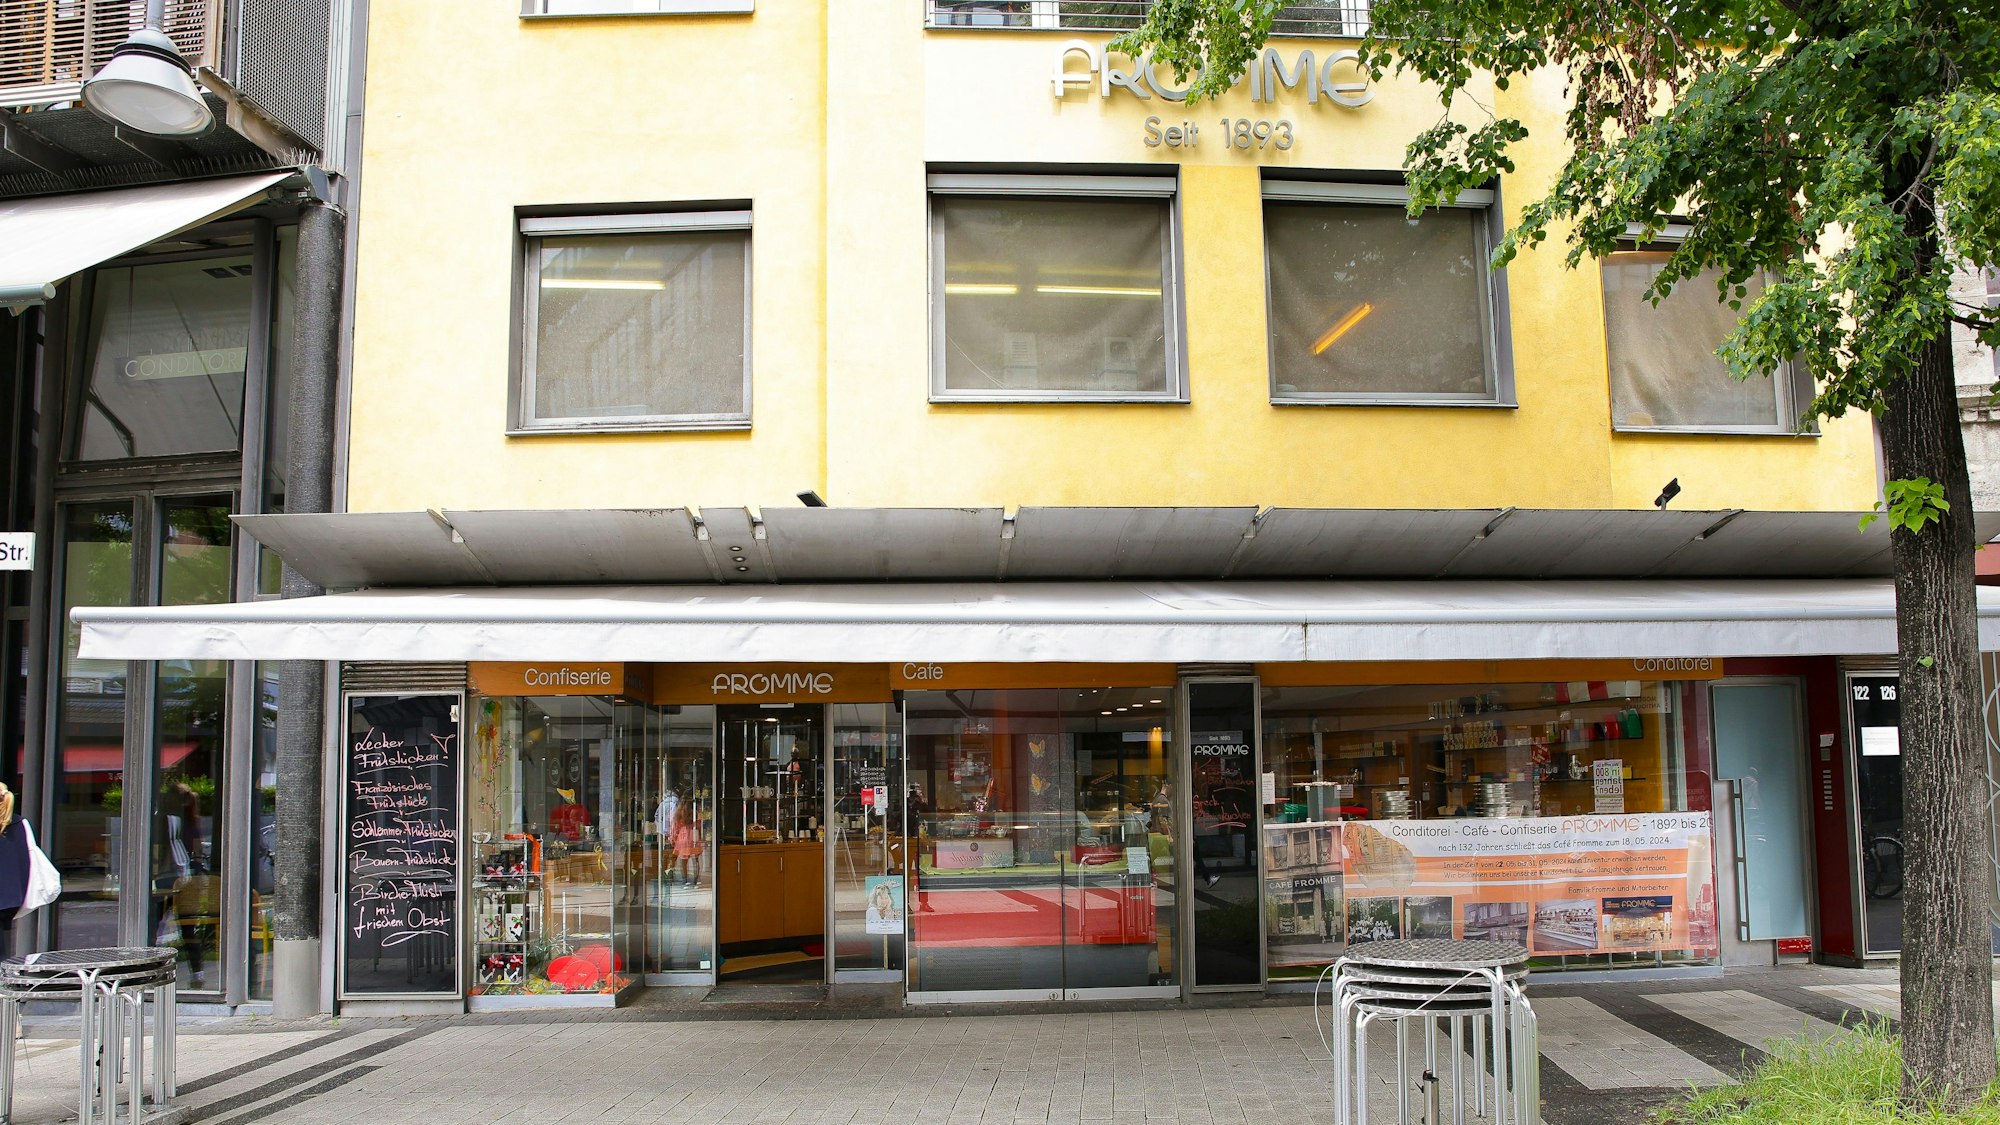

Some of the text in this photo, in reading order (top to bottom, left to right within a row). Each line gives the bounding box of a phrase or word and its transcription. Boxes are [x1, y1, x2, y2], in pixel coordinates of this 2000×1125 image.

[1144, 115, 1295, 151] Seit 1893
[0, 541, 28, 561] Str.
[1633, 657, 1713, 672] Conditorei
[524, 668, 612, 686] Confiserie
[711, 672, 834, 695] FROMME
[1853, 685, 1896, 700] 122 126
[355, 727, 404, 752] Lecker
[1193, 744, 1250, 756] FROMME
[356, 792, 429, 809] Frühstück
[1392, 825, 1451, 837] Conditorei
[1462, 824, 1489, 836] Café
[1500, 823, 1557, 836] Confiserie
[1560, 817, 1640, 833] FROMME
[1650, 819, 1677, 830] 1892
[1681, 818, 1697, 829] bis
[1438, 843, 1457, 852] nach
[1459, 843, 1473, 851] 132
[1475, 842, 1504, 851] Jahren
[1505, 841, 1535, 851] schließt
[1537, 841, 1551, 849] das
[1553, 840, 1571, 849] Café
[1572, 839, 1603, 847] Fromme
[1454, 861, 1464, 869] der
[1269, 875, 1336, 889] CAFE FROMME
[1567, 886, 1591, 894] Familie
[1592, 885, 1616, 893] Fromme
[375, 902, 396, 916] mit
[1621, 899, 1656, 908] FROMME
[407, 908, 451, 928] Obst
